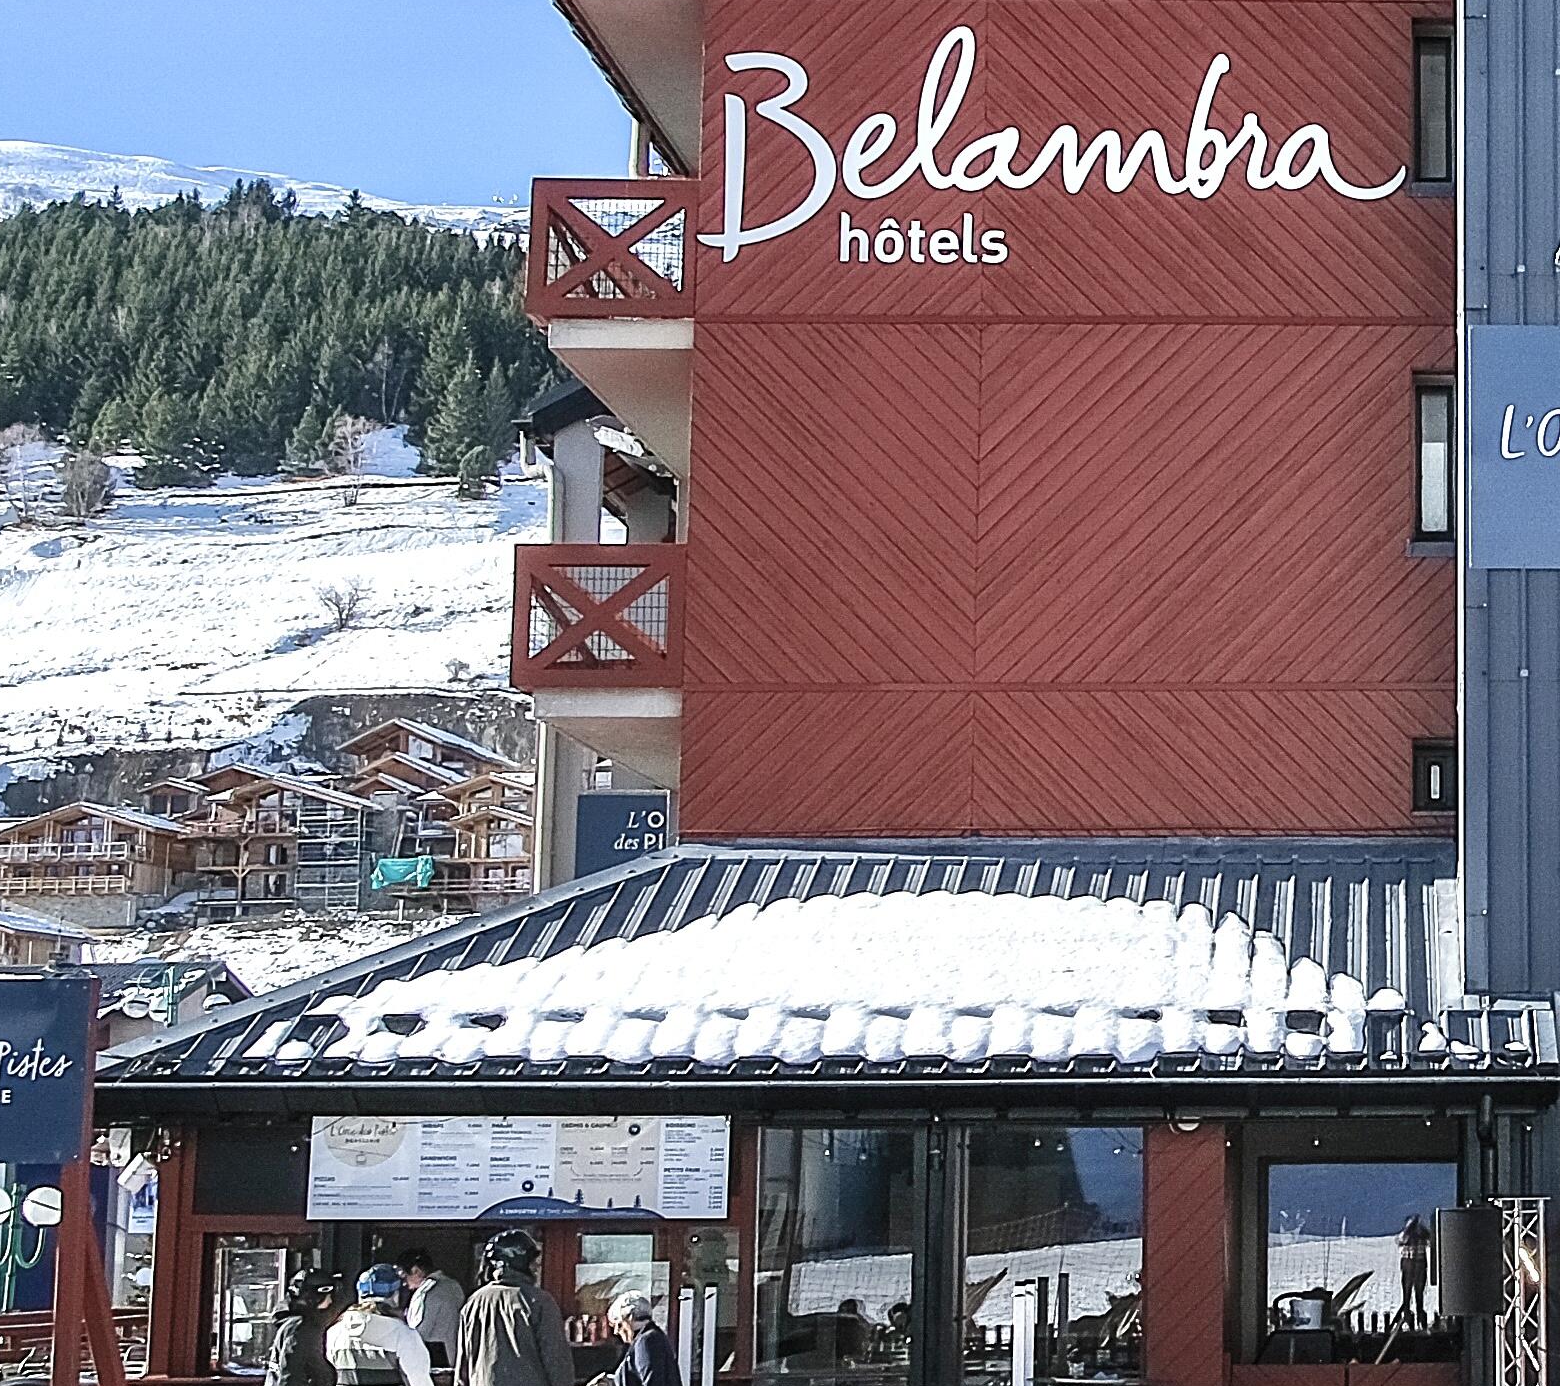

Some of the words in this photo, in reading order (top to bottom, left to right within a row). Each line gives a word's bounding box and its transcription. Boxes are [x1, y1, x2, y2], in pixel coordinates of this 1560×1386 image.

[698, 25, 1407, 263] Belambra
[840, 213, 1009, 265] hôtels
[614, 833, 640, 850] des
